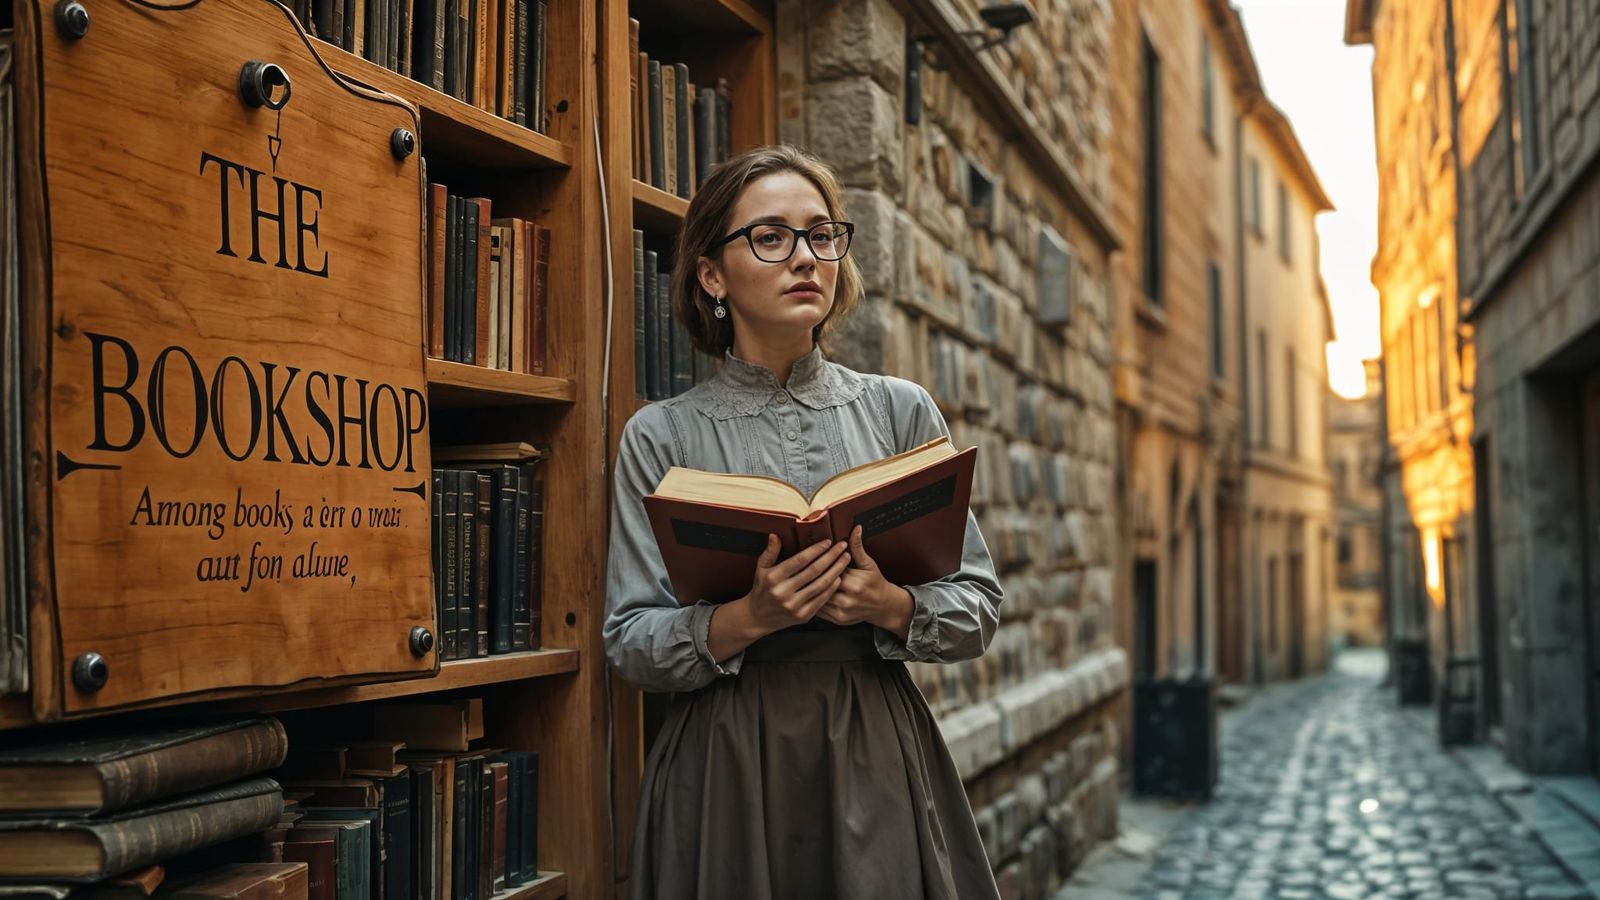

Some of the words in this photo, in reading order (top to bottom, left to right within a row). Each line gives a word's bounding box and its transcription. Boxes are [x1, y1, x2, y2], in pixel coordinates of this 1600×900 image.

[200, 151, 328, 278] THE
[83, 331, 426, 473] BOOKSHOP
[130, 485, 226, 540] Among
[303, 505, 313, 528] a
